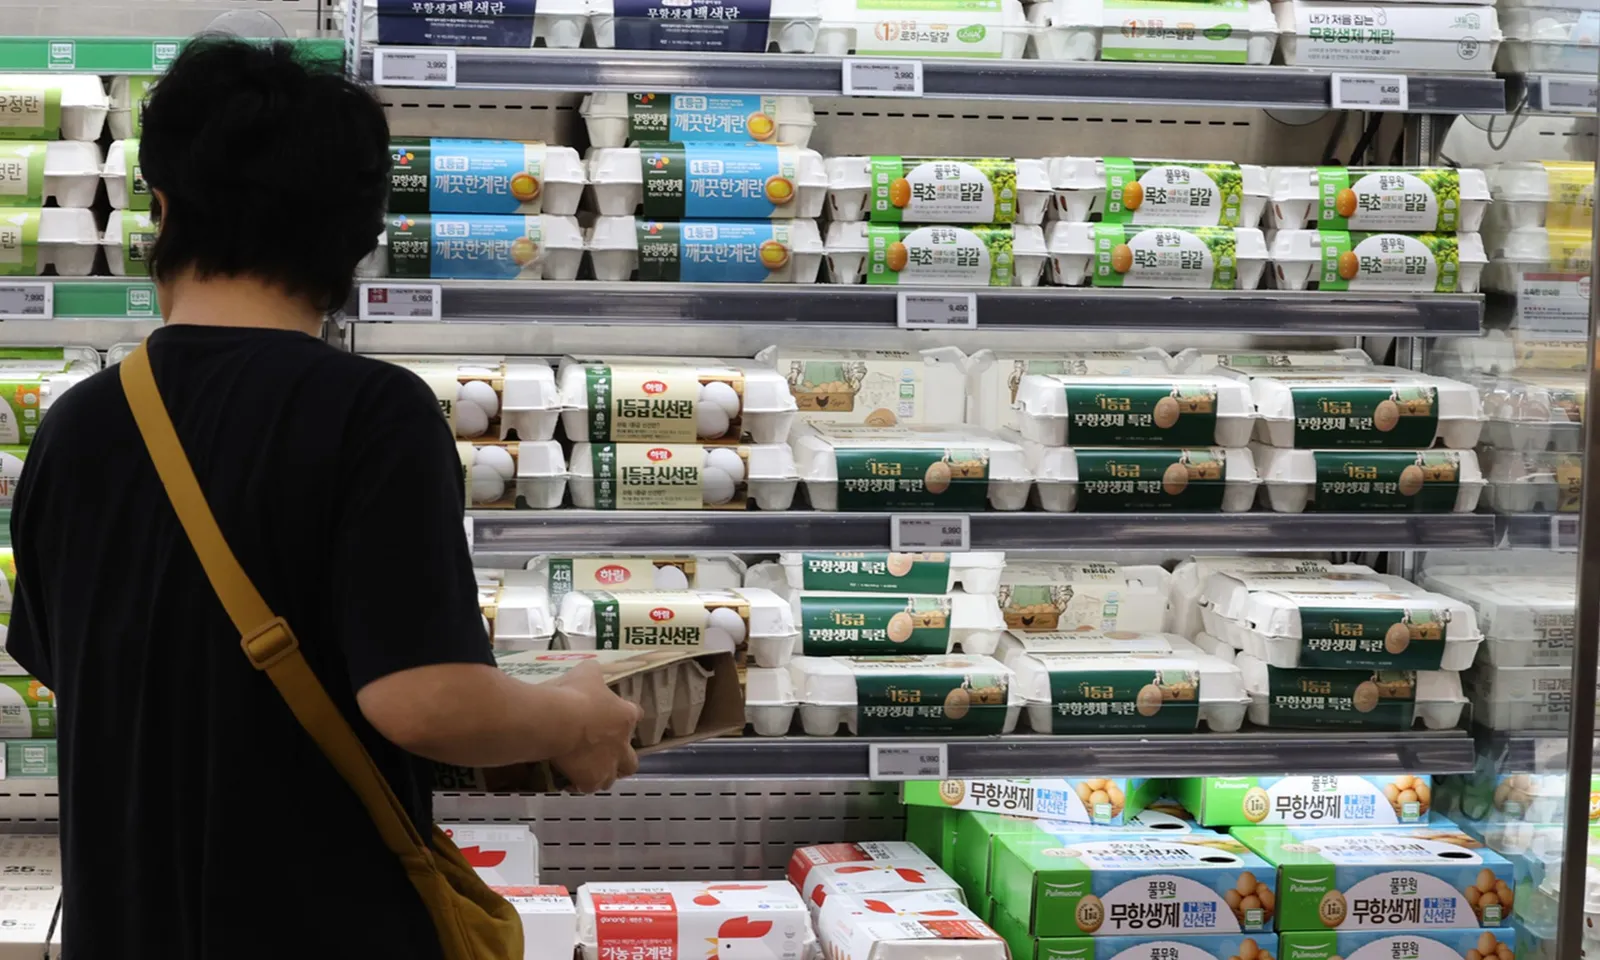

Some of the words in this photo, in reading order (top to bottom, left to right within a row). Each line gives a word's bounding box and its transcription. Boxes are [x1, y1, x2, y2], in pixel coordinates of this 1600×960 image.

[412, 2, 457, 14] 무항생제
[459, 1, 505, 15] 백색란
[647, 8, 692, 20] 무항생제
[694, 7, 740, 20] 백색란
[1309, 14, 1329, 25] 내가
[1354, 14, 1373, 25] 집는
[900, 31, 949, 43] 로하스달걀
[1309, 28, 1364, 44] 무항생제
[1367, 29, 1394, 45] 계란
[678, 97, 706, 109] 1등급
[633, 114, 668, 126] 무항생제
[675, 113, 746, 134] 깨끗한계란
[437, 157, 468, 170] 1등급
[693, 161, 720, 173] 1등급
[934, 164, 961, 180] 풀무원
[1165, 168, 1190, 184] 풀무원
[391, 175, 428, 188] 무항생제
[435, 175, 510, 195] 깨끗한계란
[647, 180, 683, 193] 무항생제
[1379, 175, 1405, 190] 풀무원
[690, 179, 764, 199] 깨끗한계란
[913, 183, 936, 202] 목초
[960, 183, 985, 202] 달걀
[1145, 187, 1167, 205] 목초
[1190, 187, 1212, 207] 달걀
[1358, 193, 1381, 212] 목초
[1404, 193, 1428, 212] 달걀
[438, 223, 468, 236] 1등급
[687, 226, 716, 238] 1등급
[931, 229, 957, 244] 풀무원
[1155, 231, 1181, 247] 풀무원
[1380, 238, 1405, 253] 풀무원
[392, 241, 428, 254] 무항생제
[436, 240, 510, 260] 깨끗한계란
[642, 243, 678, 257] 무항생제
[685, 243, 757, 263] 깨끗한계란
[910, 247, 933, 266] 목초
[956, 247, 980, 266] 달걀
[1135, 249, 1157, 268] 목초
[1181, 250, 1204, 270] 달걀
[1360, 256, 1382, 275] 목초
[1405, 256, 1428, 274] 달걀
[645, 382, 664, 392] 하림
[616, 399, 693, 419] 1등급신선란
[1100, 397, 1131, 411] 1등급
[1322, 401, 1352, 415] 1등급
[1075, 413, 1125, 428] 무항생제
[1128, 413, 1153, 428] 특란
[1297, 418, 1346, 431] 무항생제
[1349, 418, 1373, 431] 특란
[650, 450, 668, 459] 하림
[621, 466, 698, 486] 1등급신선란
[870, 462, 902, 476] 1등급
[1109, 464, 1141, 478] 1등급
[1348, 466, 1378, 480] 1등급
[844, 479, 895, 493] 무항생제
[899, 479, 924, 493] 특란
[1084, 481, 1134, 494] 무항생제
[1136, 481, 1161, 494] 특란
[1322, 482, 1370, 495] 무항생제
[1374, 482, 1398, 495] 특란
[809, 560, 859, 574] 무항생제
[861, 561, 886, 575] 특란
[600, 568, 624, 582] 하림
[652, 610, 671, 620] 하림
[835, 613, 865, 626] 1등급
[624, 626, 701, 646] 1등급신선란
[809, 629, 859, 642] 무항생제
[861, 629, 886, 642] 특란
[1334, 623, 1363, 636] 1등급
[1307, 639, 1356, 652] 무항생제
[1359, 639, 1383, 652] 특란
[1083, 686, 1114, 699] 1등급
[1301, 680, 1331, 694] 1등급
[890, 689, 921, 703] 1등급
[1275, 696, 1324, 709] 무항생제
[1328, 697, 1351, 710] 특란
[864, 705, 914, 718] 무항생제
[918, 705, 942, 718] 특란
[1058, 702, 1108, 716] 무항생제
[1112, 702, 1136, 716] 특란
[1214, 780, 1249, 789] Pulmuone
[1312, 775, 1338, 792] 풀무원
[970, 782, 1034, 811] 무항생제
[1036, 798, 1068, 816] 신선란
[1275, 795, 1341, 820] 무항생제
[1344, 805, 1375, 819] 신선란
[1045, 888, 1083, 898] Pulmuone
[1147, 881, 1176, 900] 풀무원
[1290, 884, 1326, 893] Pulmuone
[1390, 877, 1417, 895] 풀무원
[1110, 903, 1181, 930] 무항생제
[1352, 898, 1421, 925] 무항생제
[1423, 909, 1456, 924] 신선란
[1183, 912, 1217, 928] 신선란
[601, 947, 630, 960] 가농
[631, 946, 673, 960] 금계란
[1391, 942, 1419, 960] 풀무원
